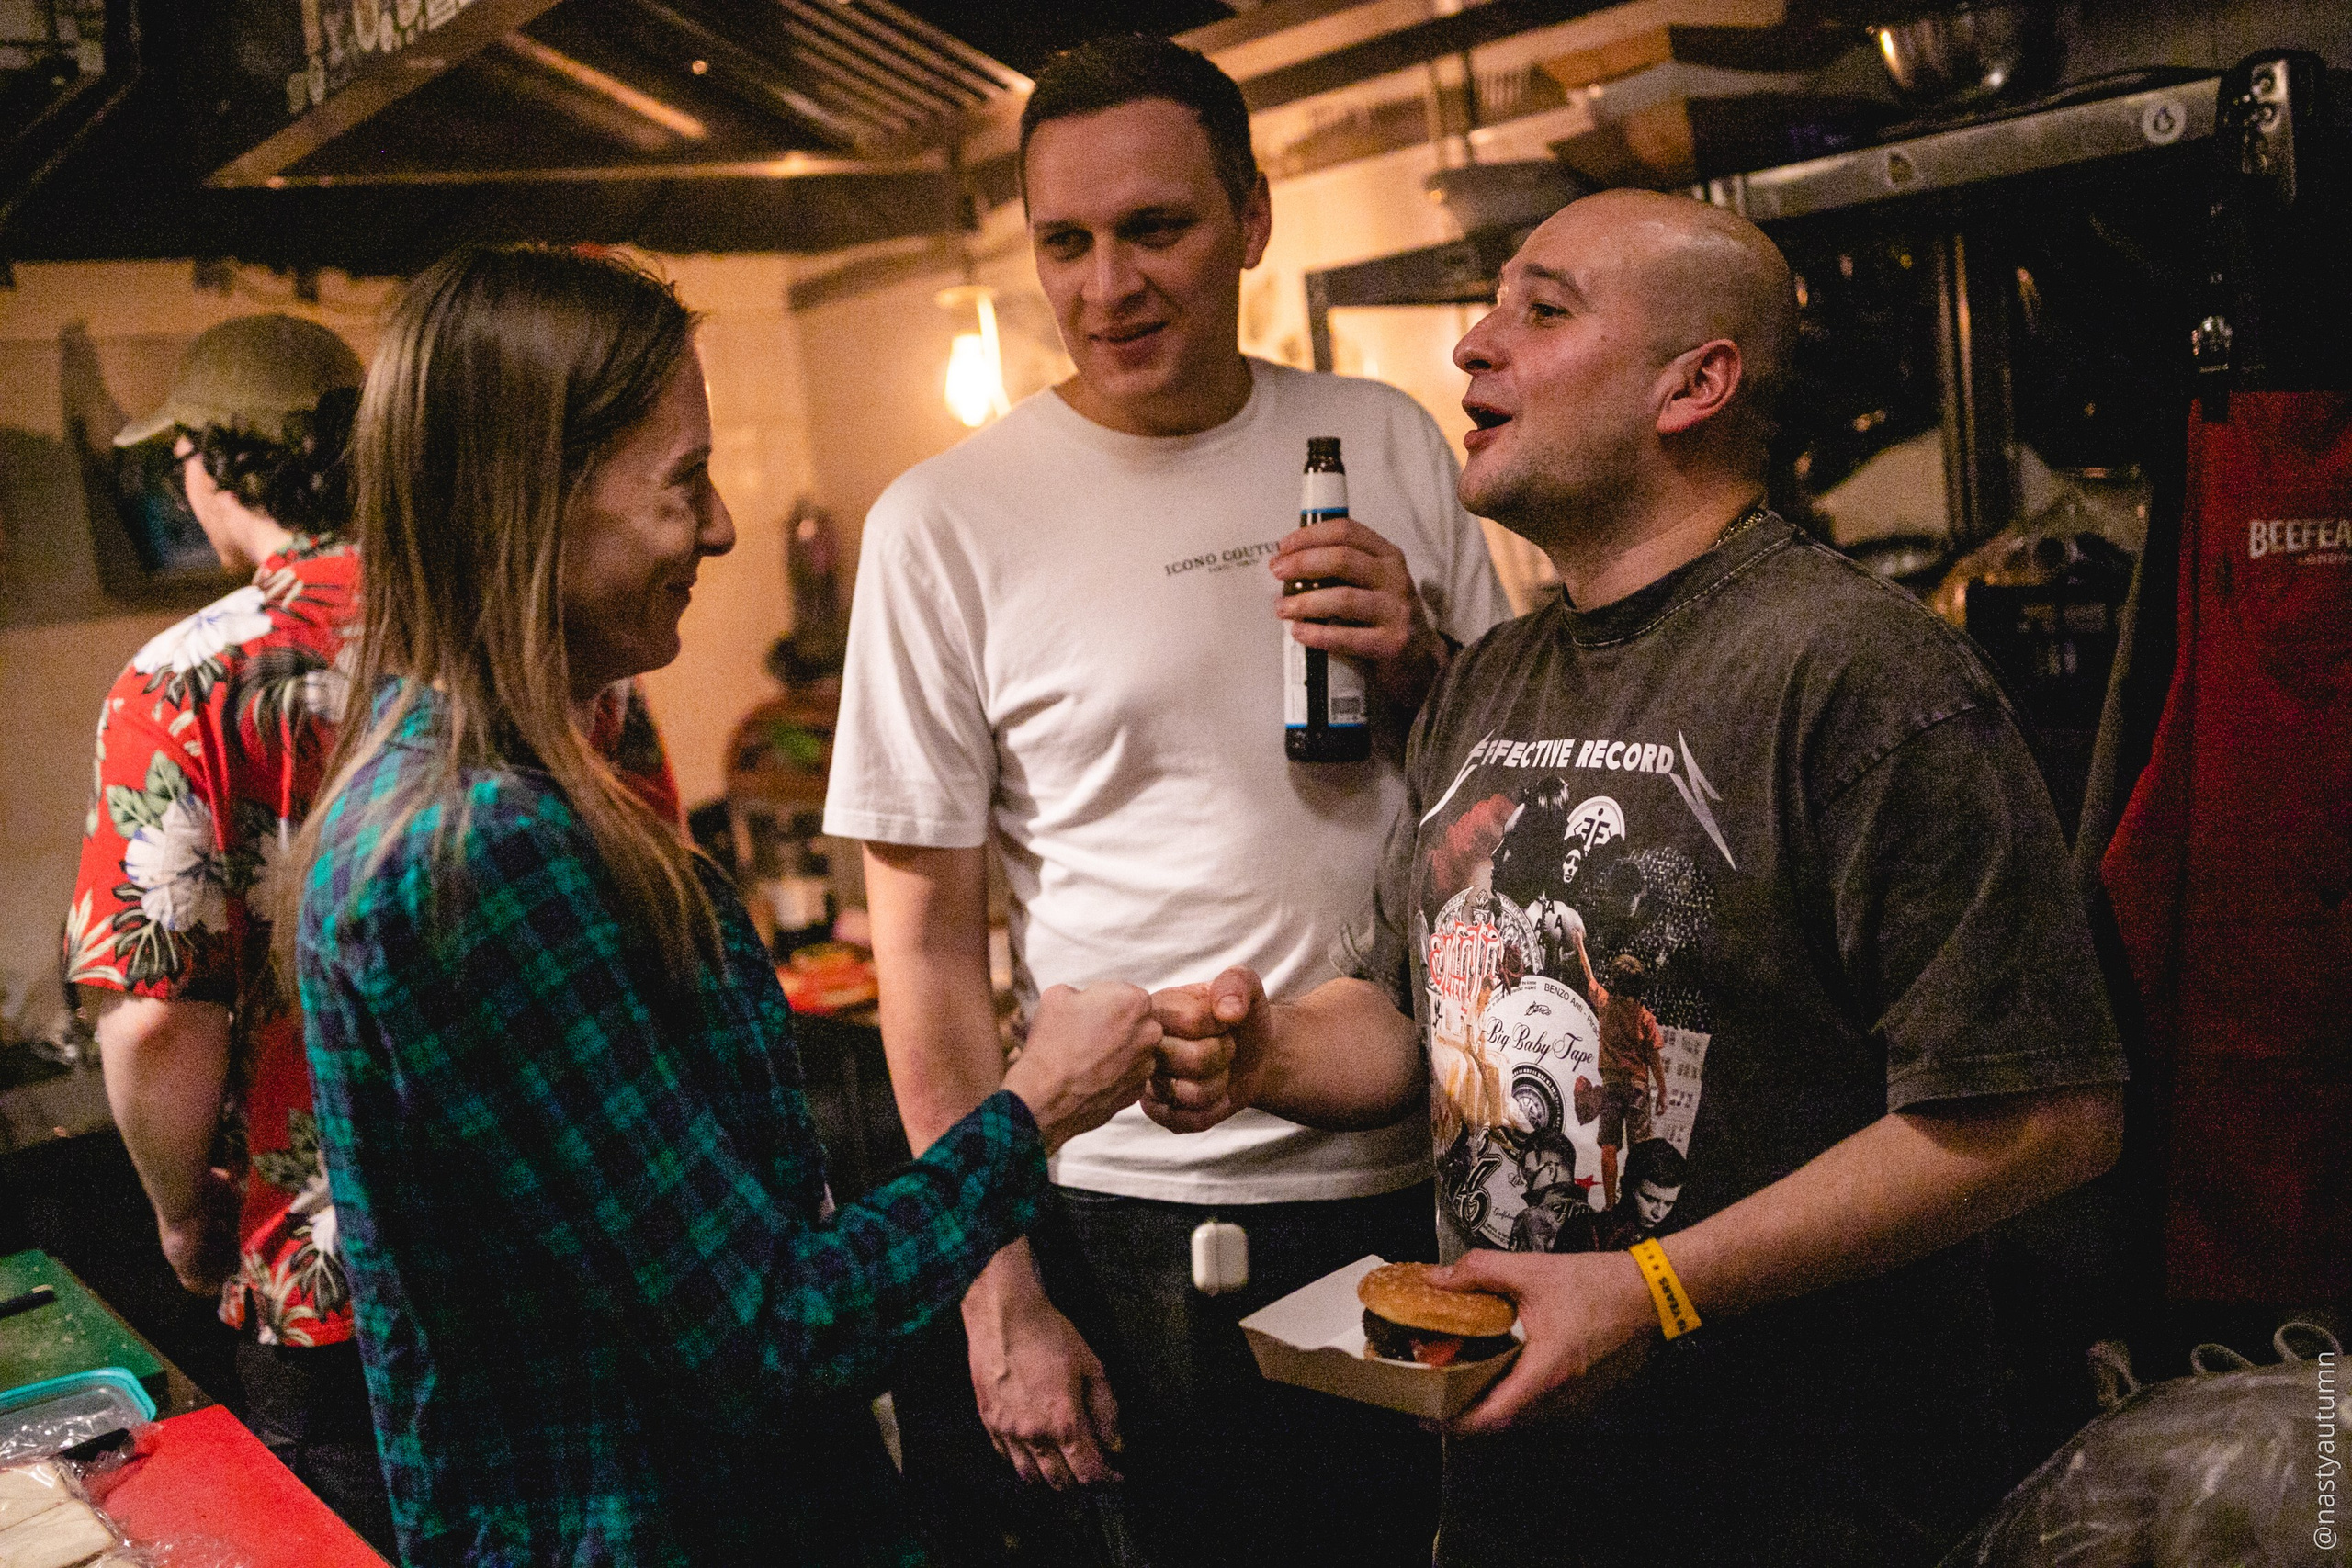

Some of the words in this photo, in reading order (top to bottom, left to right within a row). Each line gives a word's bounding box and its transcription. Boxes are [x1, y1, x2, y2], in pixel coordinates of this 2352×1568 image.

[1164, 553, 1217, 576] ICONO
[1467, 738, 1576, 768] EFFECTIVE
[1575, 739, 1674, 774] RECORD
[1544, 982, 1570, 1001] BENZO
[1486, 1016, 1512, 1052] Big
[1511, 1021, 1555, 1066] Baby
[1551, 1032, 1596, 1073] Tape
